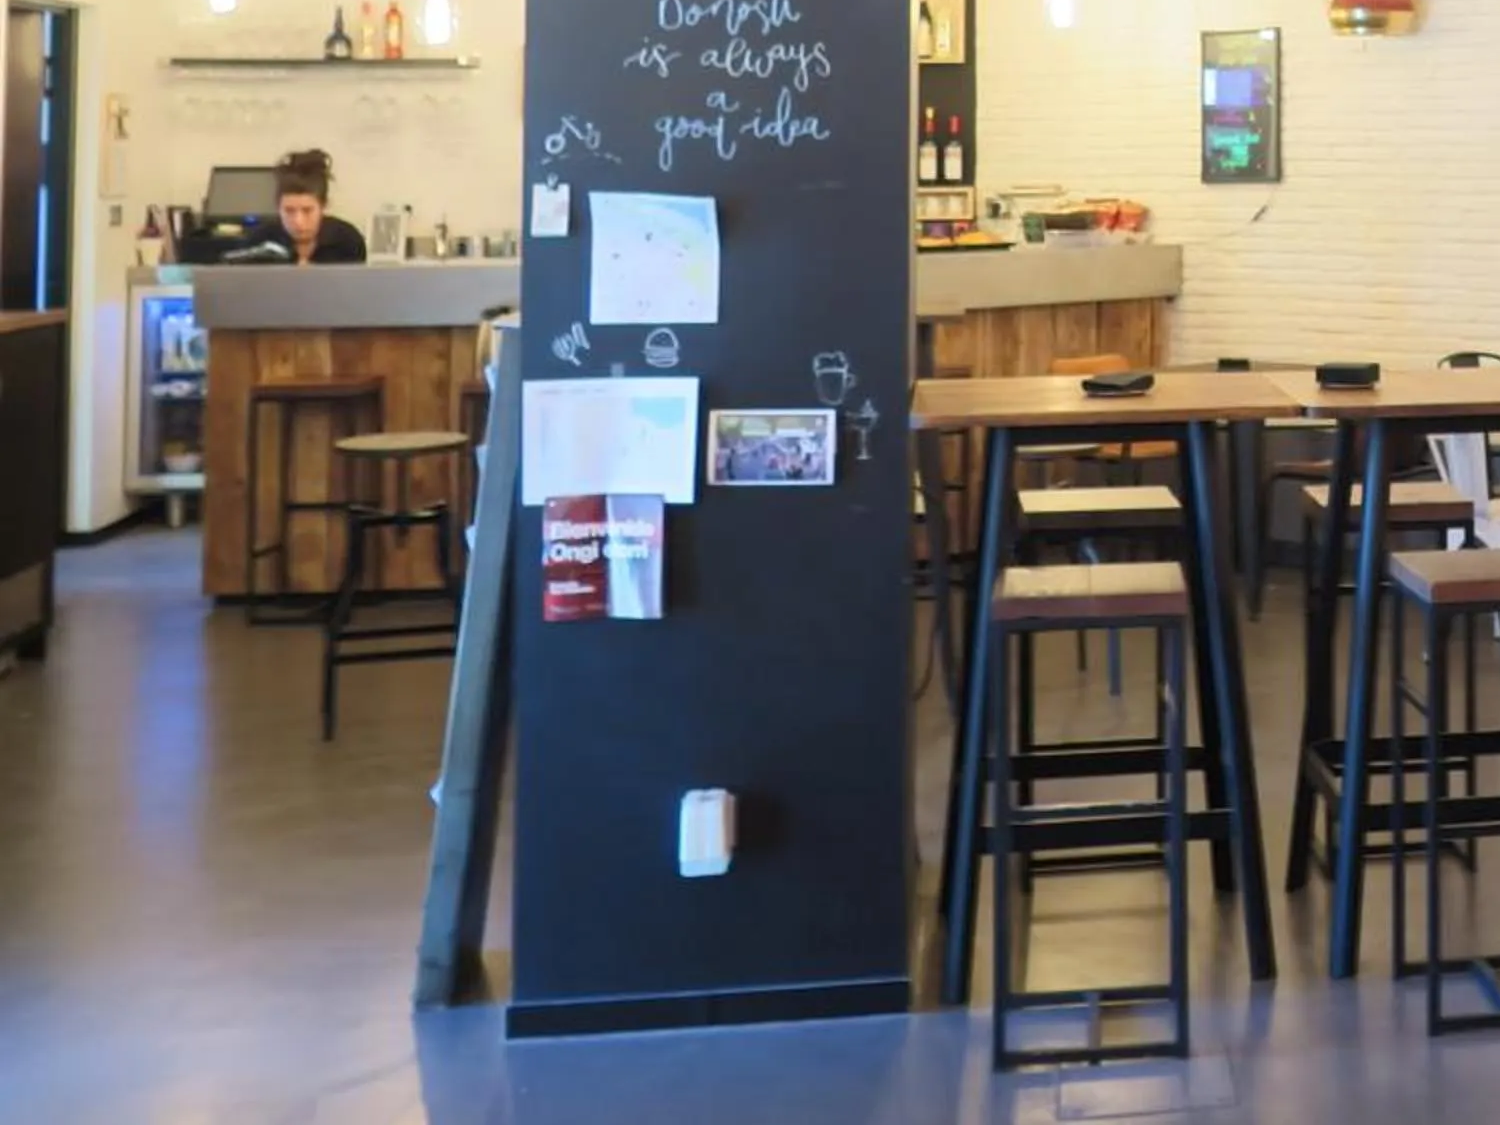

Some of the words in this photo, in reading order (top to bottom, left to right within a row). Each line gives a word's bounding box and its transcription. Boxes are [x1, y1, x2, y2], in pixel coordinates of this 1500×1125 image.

[623, 37, 682, 78] is
[700, 37, 831, 92] always
[706, 90, 740, 112] a
[655, 115, 736, 172] good
[740, 86, 831, 147] idea
